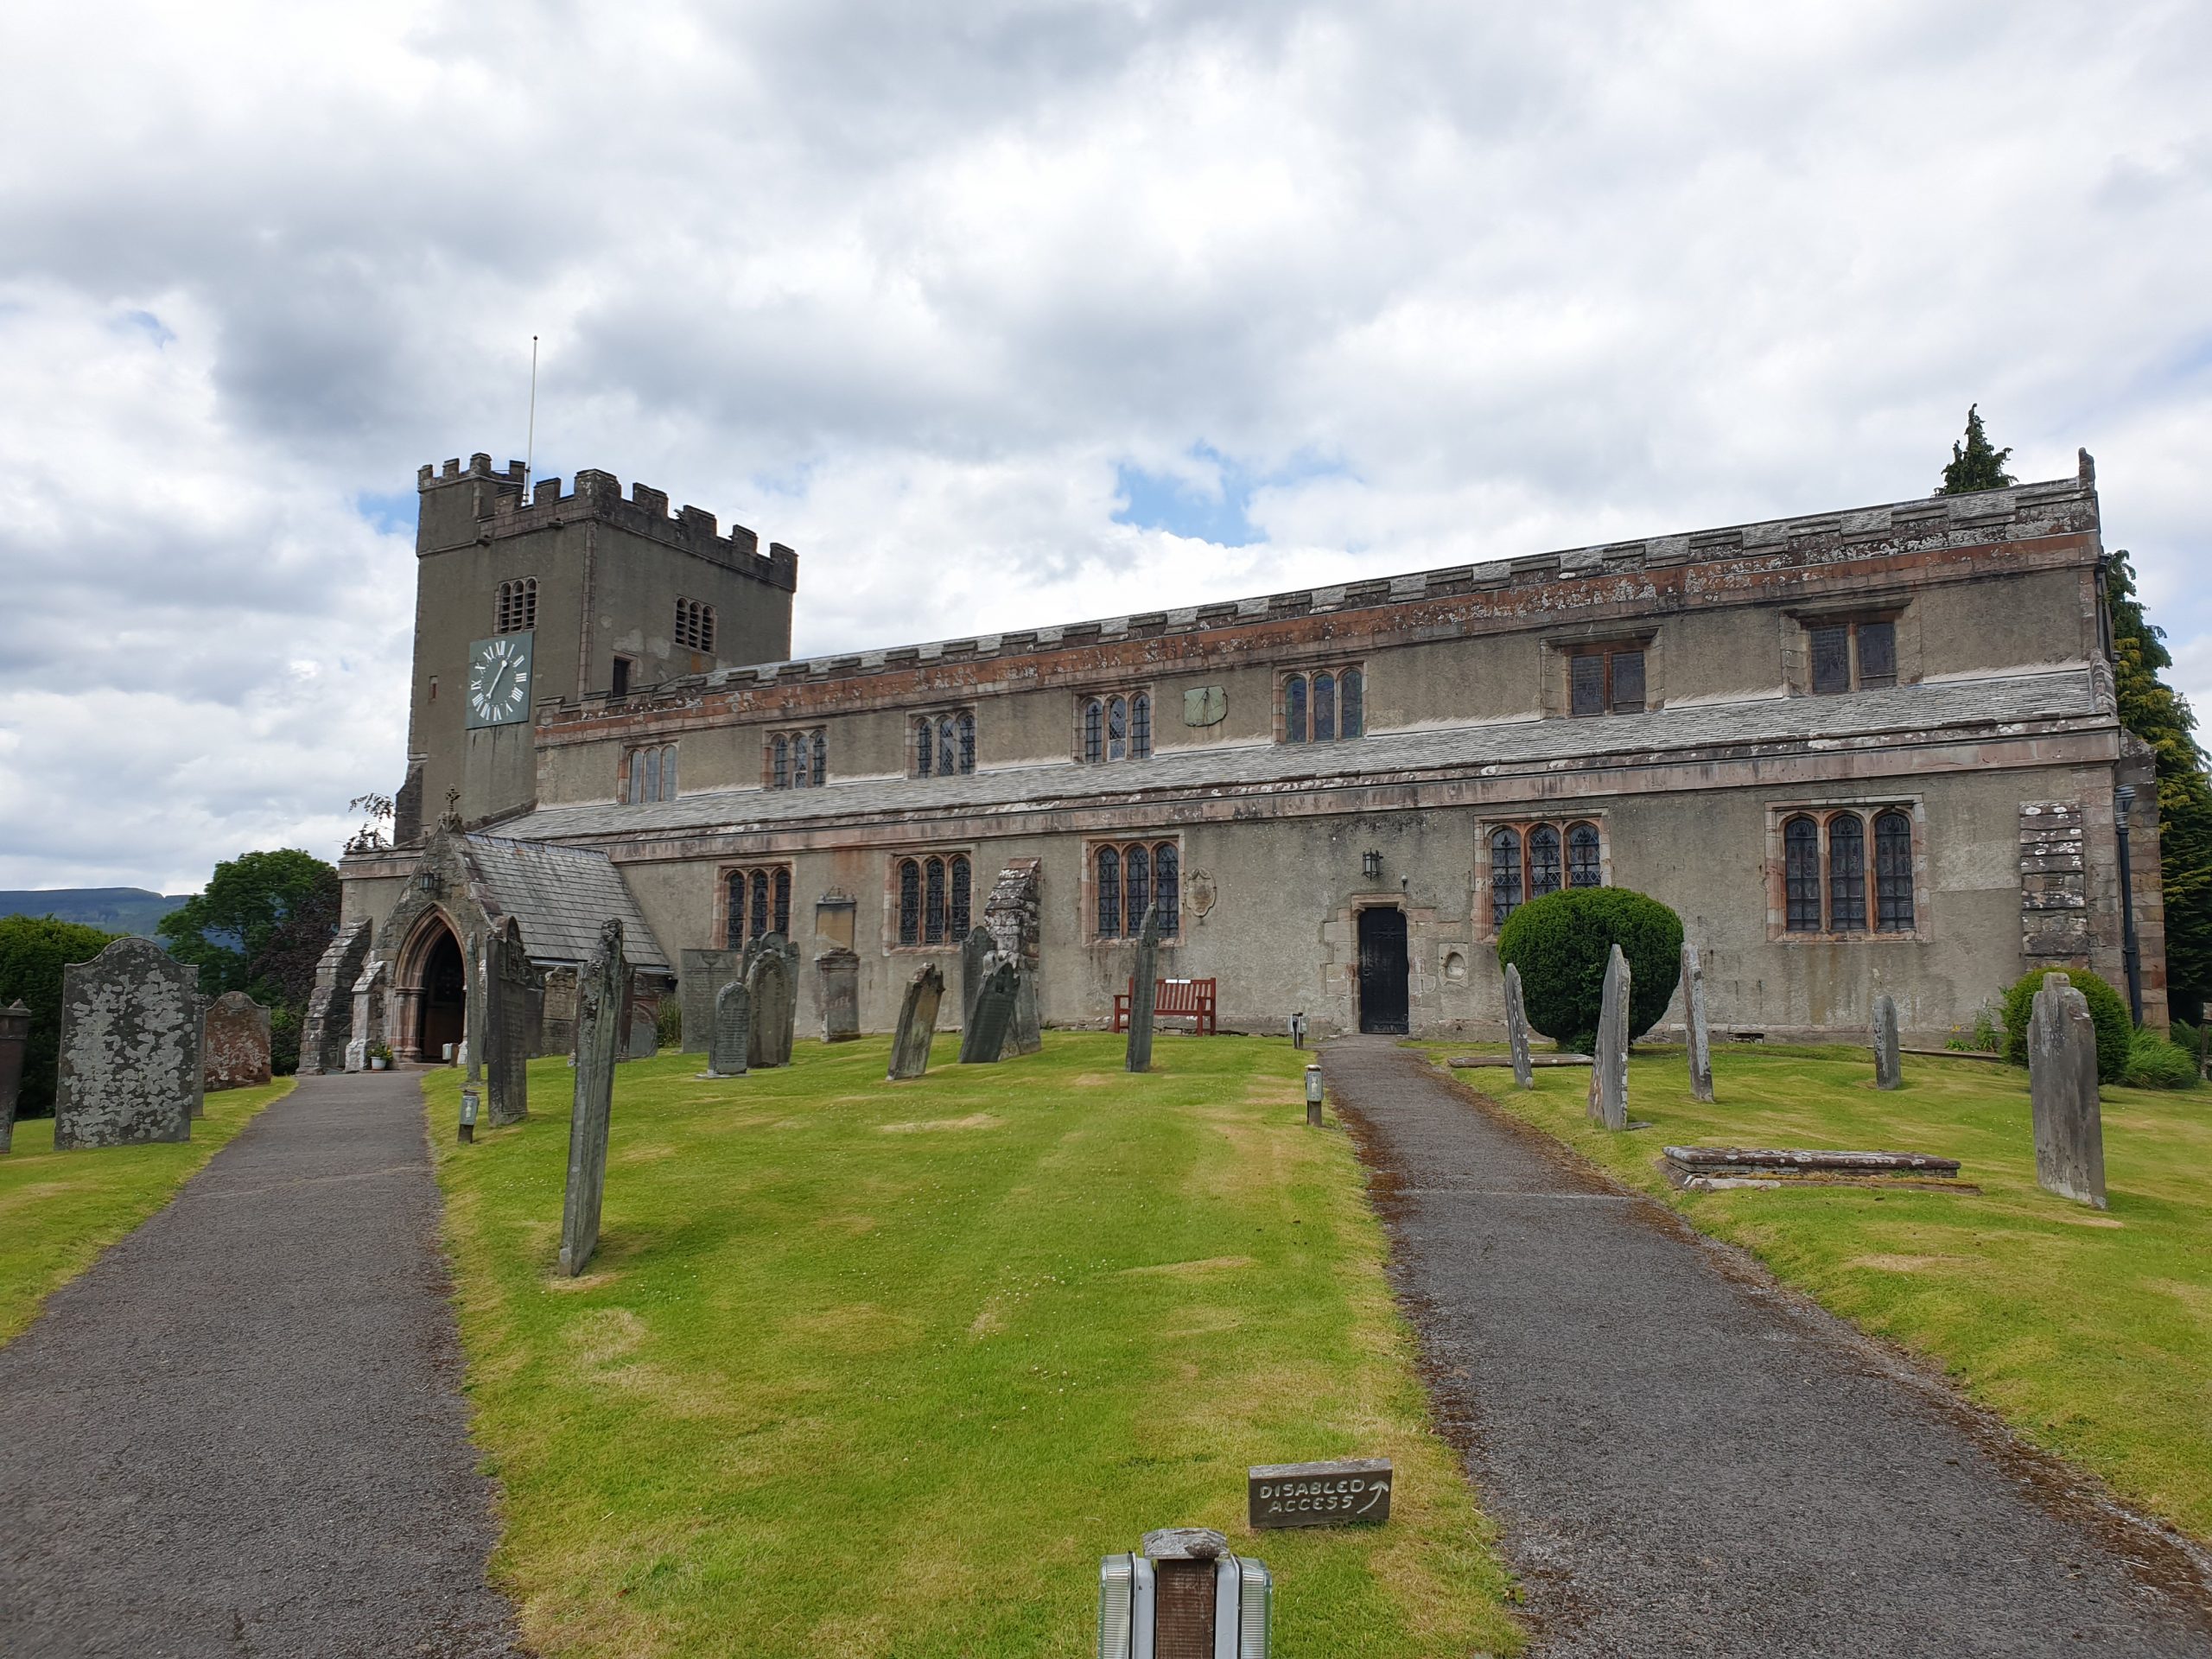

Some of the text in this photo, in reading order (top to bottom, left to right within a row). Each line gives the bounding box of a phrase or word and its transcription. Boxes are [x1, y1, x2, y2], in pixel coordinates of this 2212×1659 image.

[513, 655, 525, 667] II
[514, 672, 527, 683] III
[1259, 1478, 1365, 1499] DISABLED
[1268, 1495, 1354, 1513] ACCESS
